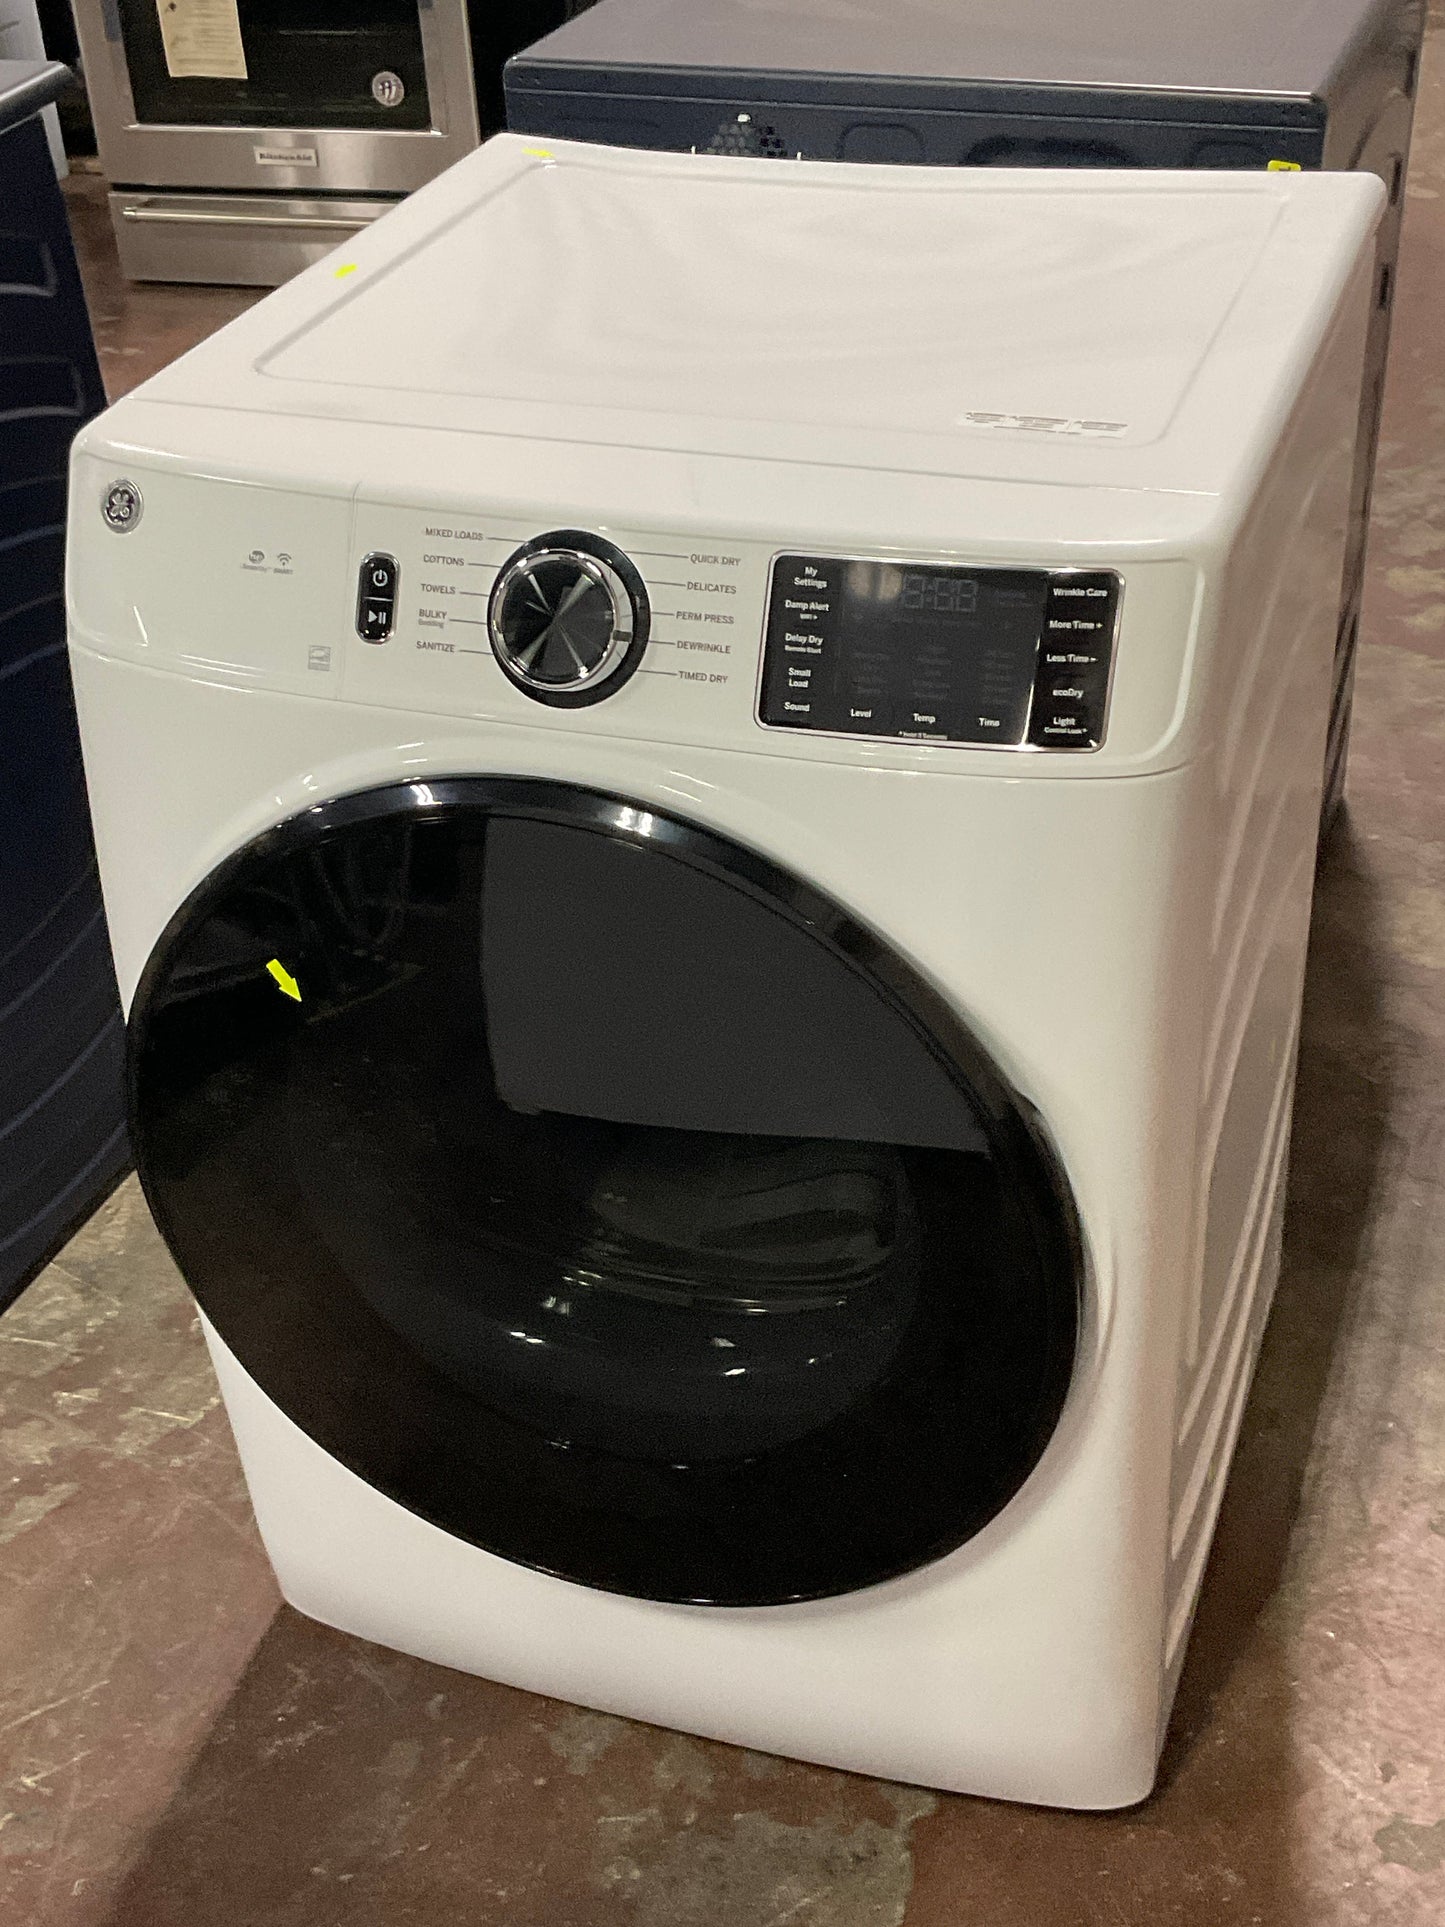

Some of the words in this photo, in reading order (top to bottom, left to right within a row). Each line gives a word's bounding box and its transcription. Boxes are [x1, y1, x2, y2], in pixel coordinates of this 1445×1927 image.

[425, 527, 453, 538] MIXED
[455, 530, 484, 541] LOADS
[423, 554, 465, 566] COTTONS
[690, 553, 720, 565] QUICK
[721, 556, 741, 566] DRY
[804, 566, 818, 577] My
[421, 583, 456, 595] TOWELS
[687, 581, 737, 595] DELICATES
[794, 577, 828, 589] Settings
[1053, 587, 1085, 597] Wrinkle
[1086, 588, 1108, 597] Care
[785, 599, 809, 611] Damp
[809, 602, 830, 612] Alert
[418, 608, 447, 620] BULKY
[676, 611, 702, 622] PERM
[704, 614, 734, 625] PRESS
[1049, 620, 1072, 629] More
[1073, 620, 1095, 629] Time
[785, 633, 808, 644] Delay
[808, 635, 824, 646] Dry
[416, 640, 455, 653] SANITIZE
[676, 640, 732, 654] DEWRINKLE
[1046, 653, 1067, 663] Less
[1067, 654, 1090, 663] Time
[678, 670, 707, 682] TIMED
[709, 673, 728, 684] DRY
[788, 667, 812, 677] Small
[788, 679, 809, 688] Load
[1052, 689, 1084, 699] ecoDry
[784, 702, 810, 712] Sound
[850, 708, 872, 719] Level
[913, 713, 936, 724] Temp
[978, 717, 1001, 727] Time
[1053, 716, 1077, 727] Light
